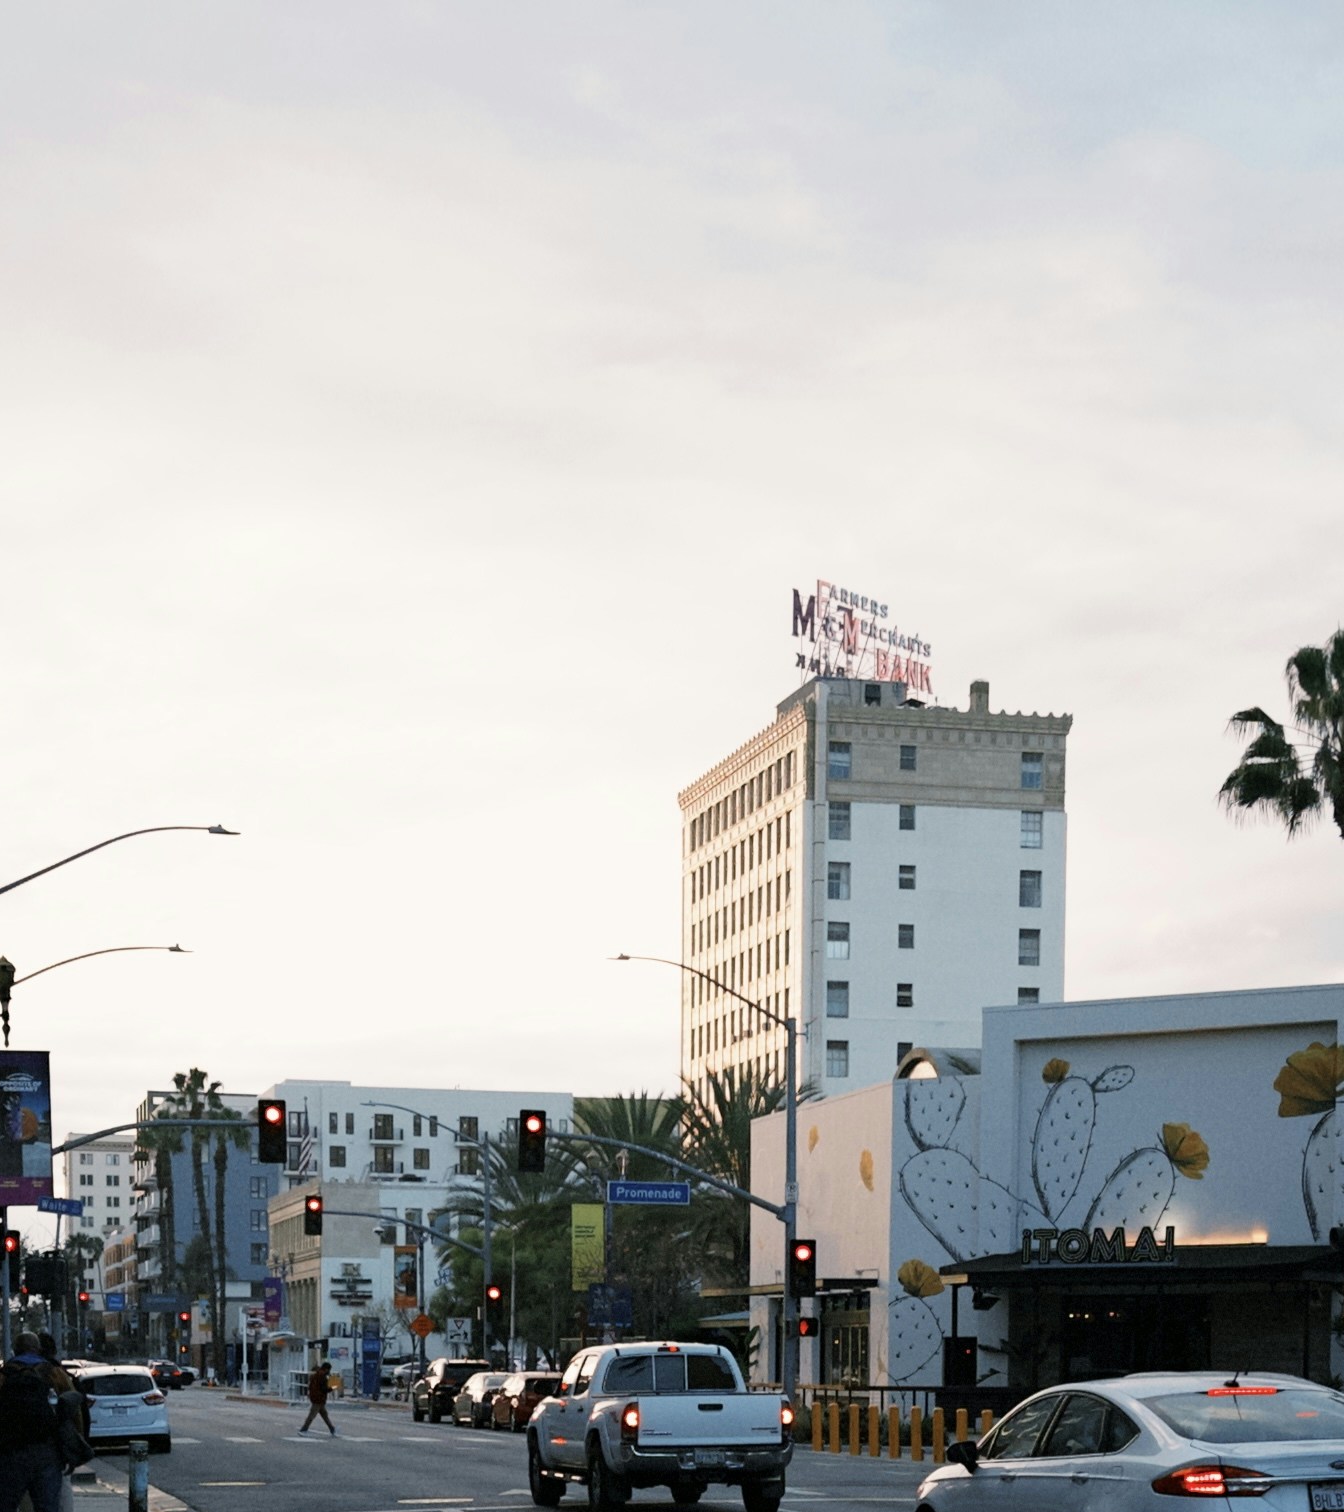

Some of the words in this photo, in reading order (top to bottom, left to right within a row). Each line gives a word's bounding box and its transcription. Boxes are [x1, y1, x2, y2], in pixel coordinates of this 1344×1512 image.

[817, 579, 888, 618] FARMERS
[876, 648, 932, 691] BANK
[616, 1186, 682, 1200] Promenade
